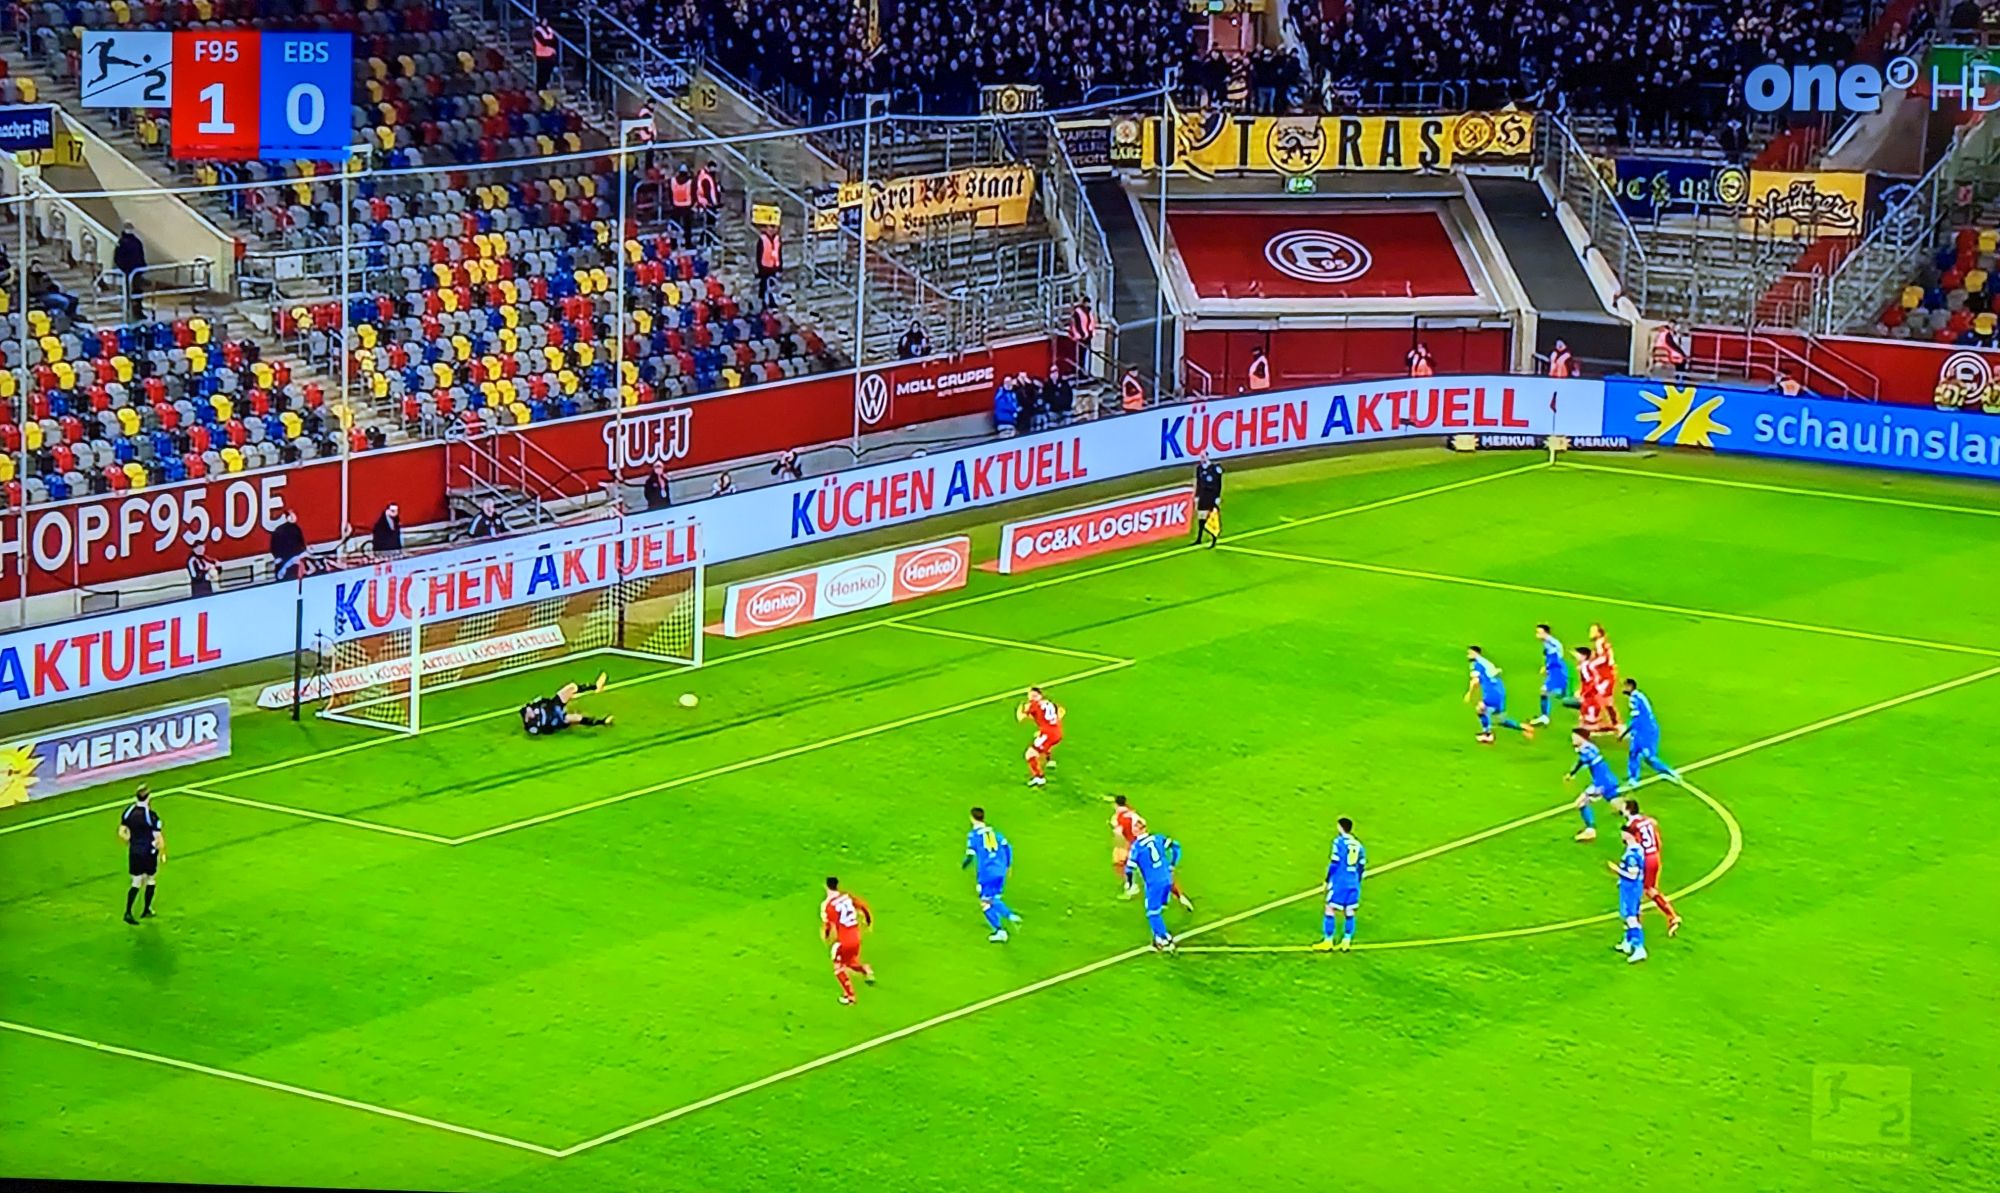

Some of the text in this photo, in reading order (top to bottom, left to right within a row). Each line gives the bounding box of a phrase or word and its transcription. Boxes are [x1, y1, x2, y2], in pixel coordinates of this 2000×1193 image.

[896, 378, 935, 396] MOLL
[937, 367, 995, 389] GRUPPE
[1160, 388, 1530, 461] KÜCHEN AKTUELL
[791, 438, 1087, 540] KÜCHEN AKTUELL
[1035, 501, 1188, 553] C&K LOGISTIK
[829, 574, 881, 599] Henkel
[906, 556, 956, 581] Henkel
[751, 593, 801, 615] Henkel
[56, 712, 218, 775] MERKUR
